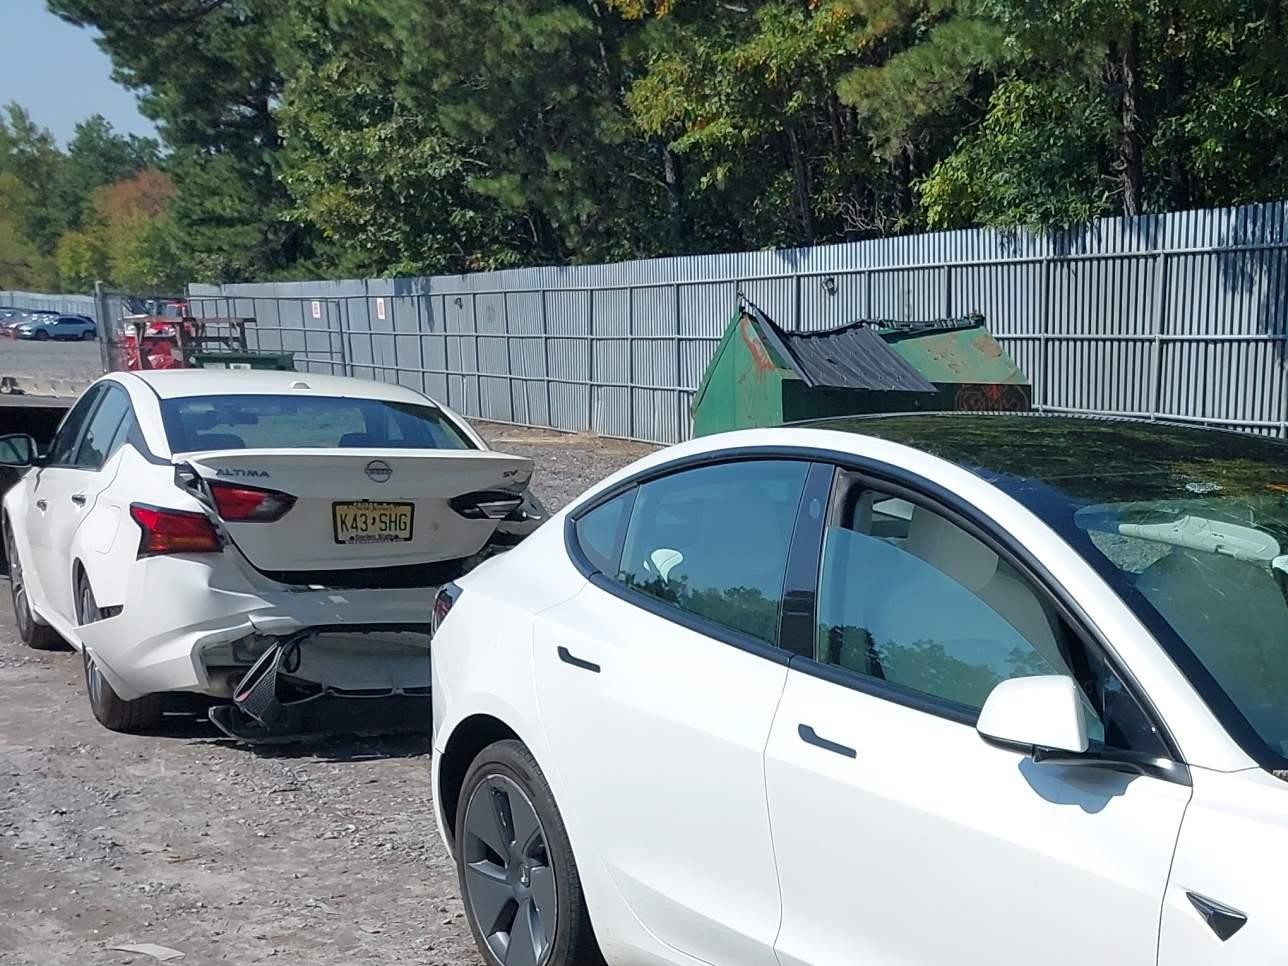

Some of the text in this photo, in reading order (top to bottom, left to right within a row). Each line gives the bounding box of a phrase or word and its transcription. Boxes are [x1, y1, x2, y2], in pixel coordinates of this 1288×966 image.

[215, 468, 270, 478] ALTIMA
[340, 513, 408, 533] K43 SHG
